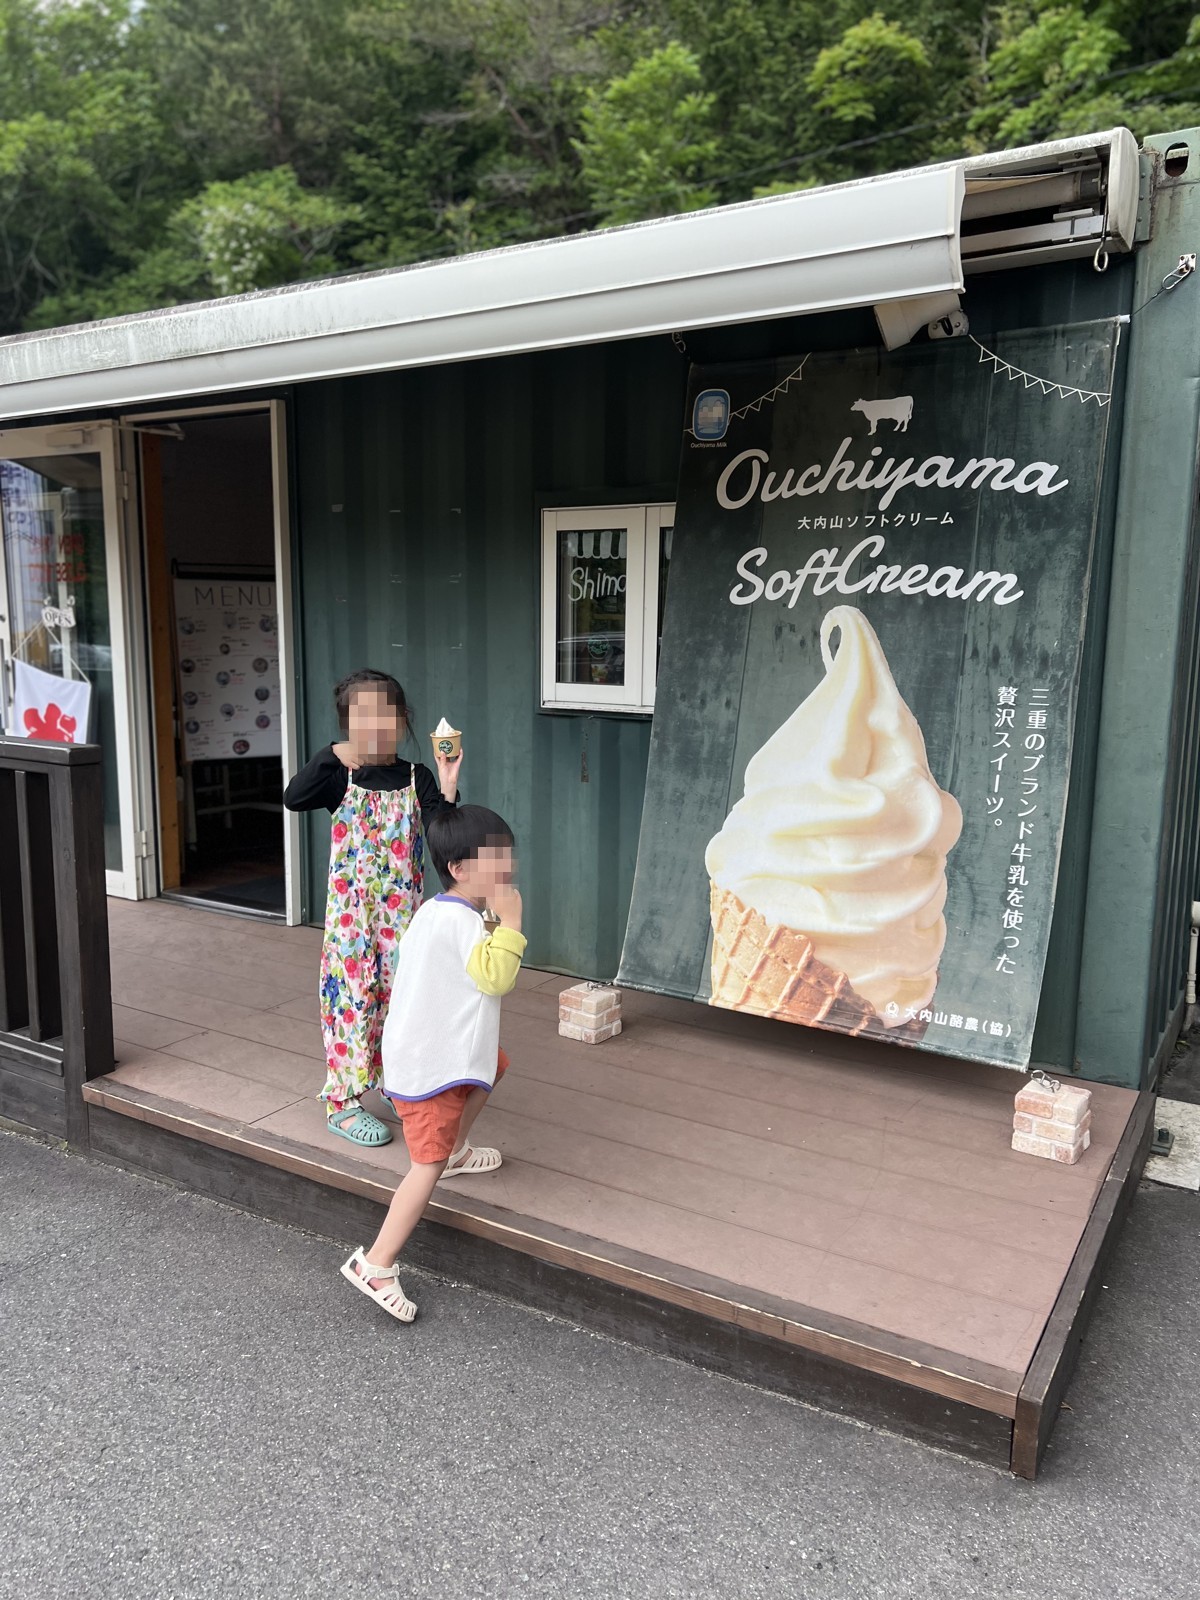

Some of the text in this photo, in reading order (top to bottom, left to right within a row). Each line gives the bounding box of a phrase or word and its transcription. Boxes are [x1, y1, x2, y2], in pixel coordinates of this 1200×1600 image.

[690, 441, 715, 450] Ouchiyama
[716, 436, 1069, 511] Ouchiyama
[797, 511, 955, 530] 大内山ソフトクリーム
[194, 585, 273, 607] MENU
[44, 611, 73, 627] OPEN
[985, 685, 1018, 827] 贅沢スイーツ。
[995, 687, 1050, 975] 三重のブランド牛乳を使った
